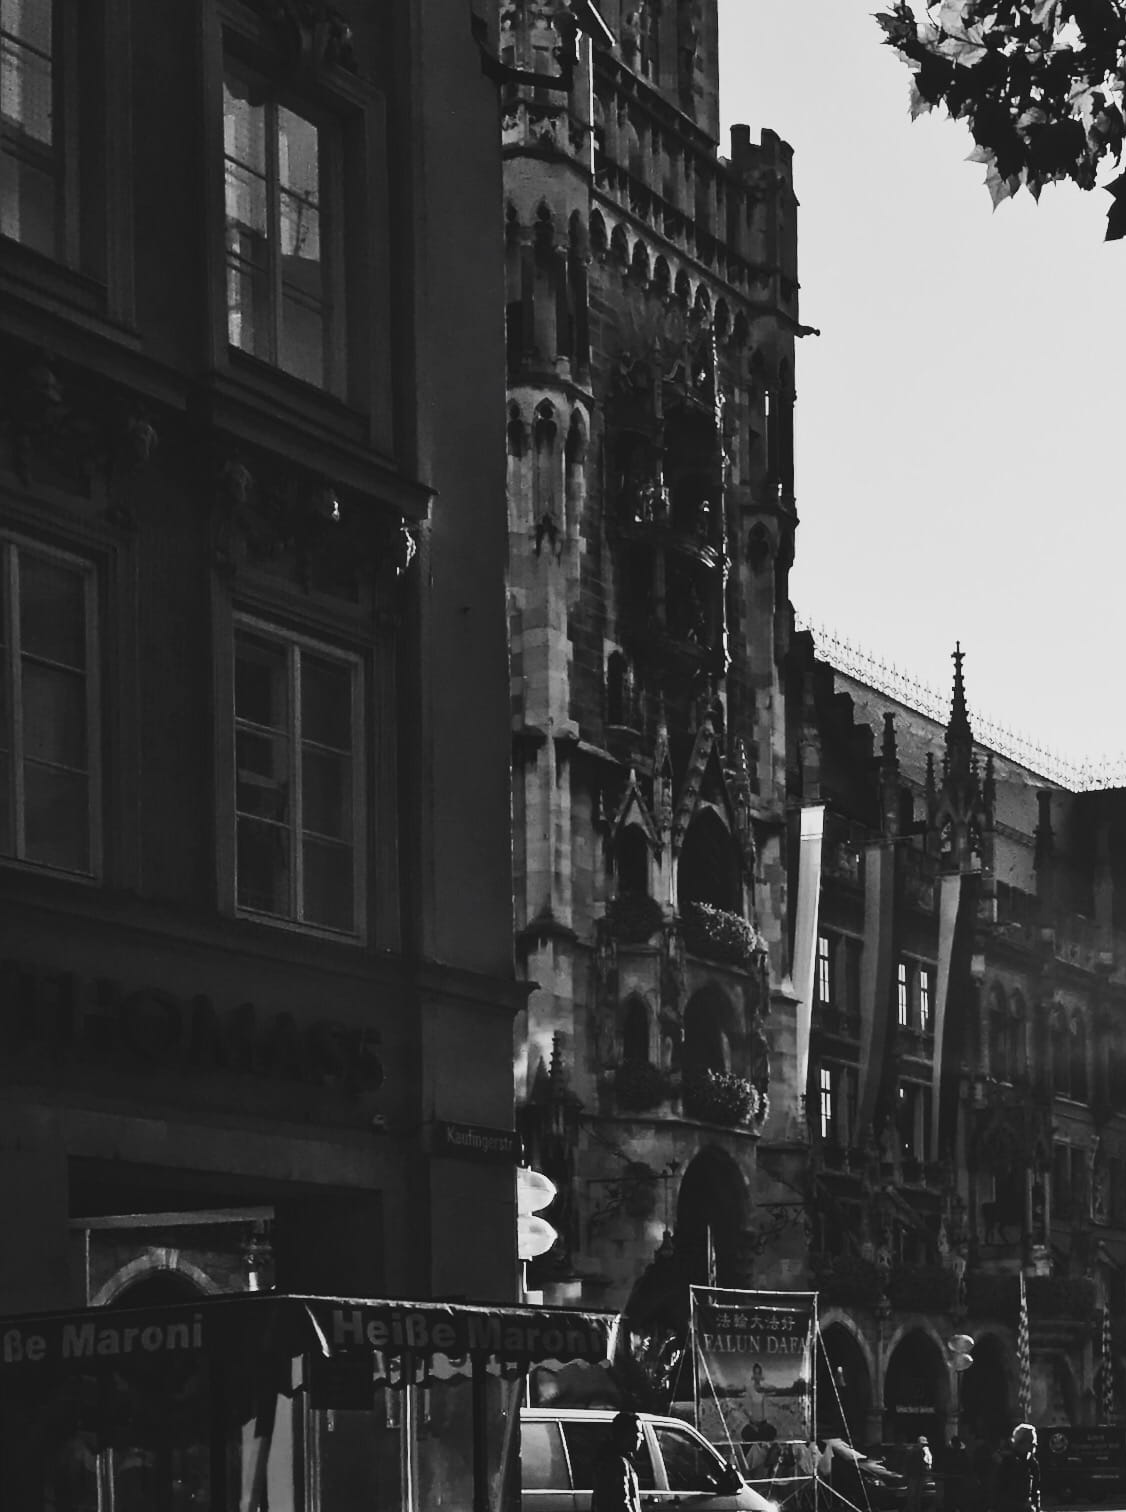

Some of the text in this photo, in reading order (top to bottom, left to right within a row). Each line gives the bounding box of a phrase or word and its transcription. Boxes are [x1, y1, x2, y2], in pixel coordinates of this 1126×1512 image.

[62, 1313, 203, 1359] Maroni
[332, 1309, 604, 1353] Heiße Maroni
[704, 1333, 761, 1353] FALUN
